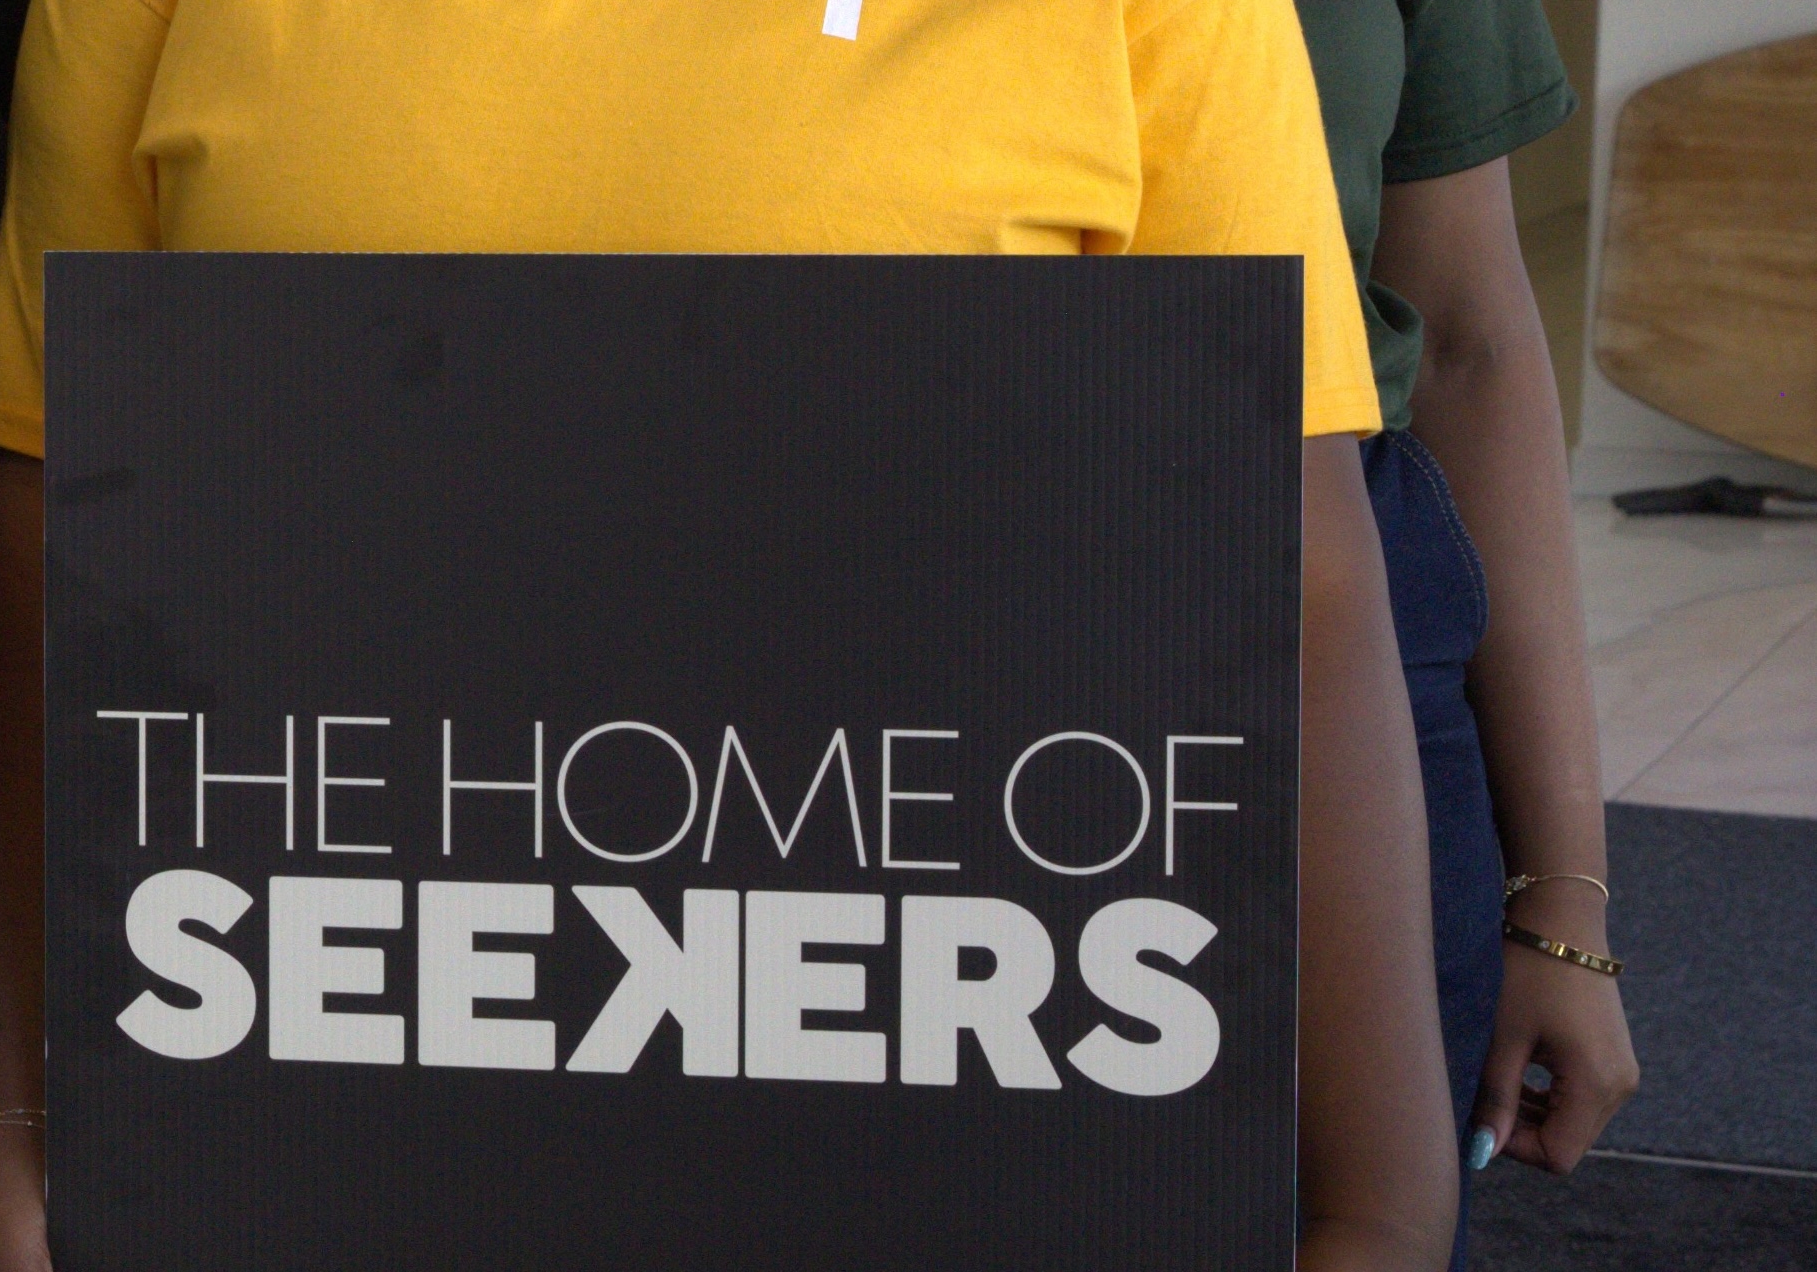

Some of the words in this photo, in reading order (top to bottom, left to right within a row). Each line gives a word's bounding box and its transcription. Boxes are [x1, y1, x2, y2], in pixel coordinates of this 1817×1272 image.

[96, 710, 393, 854] THE
[442, 718, 961, 870] HOME
[1003, 731, 1244, 876] OF
[115, 868, 1221, 1097] SEEKERS
